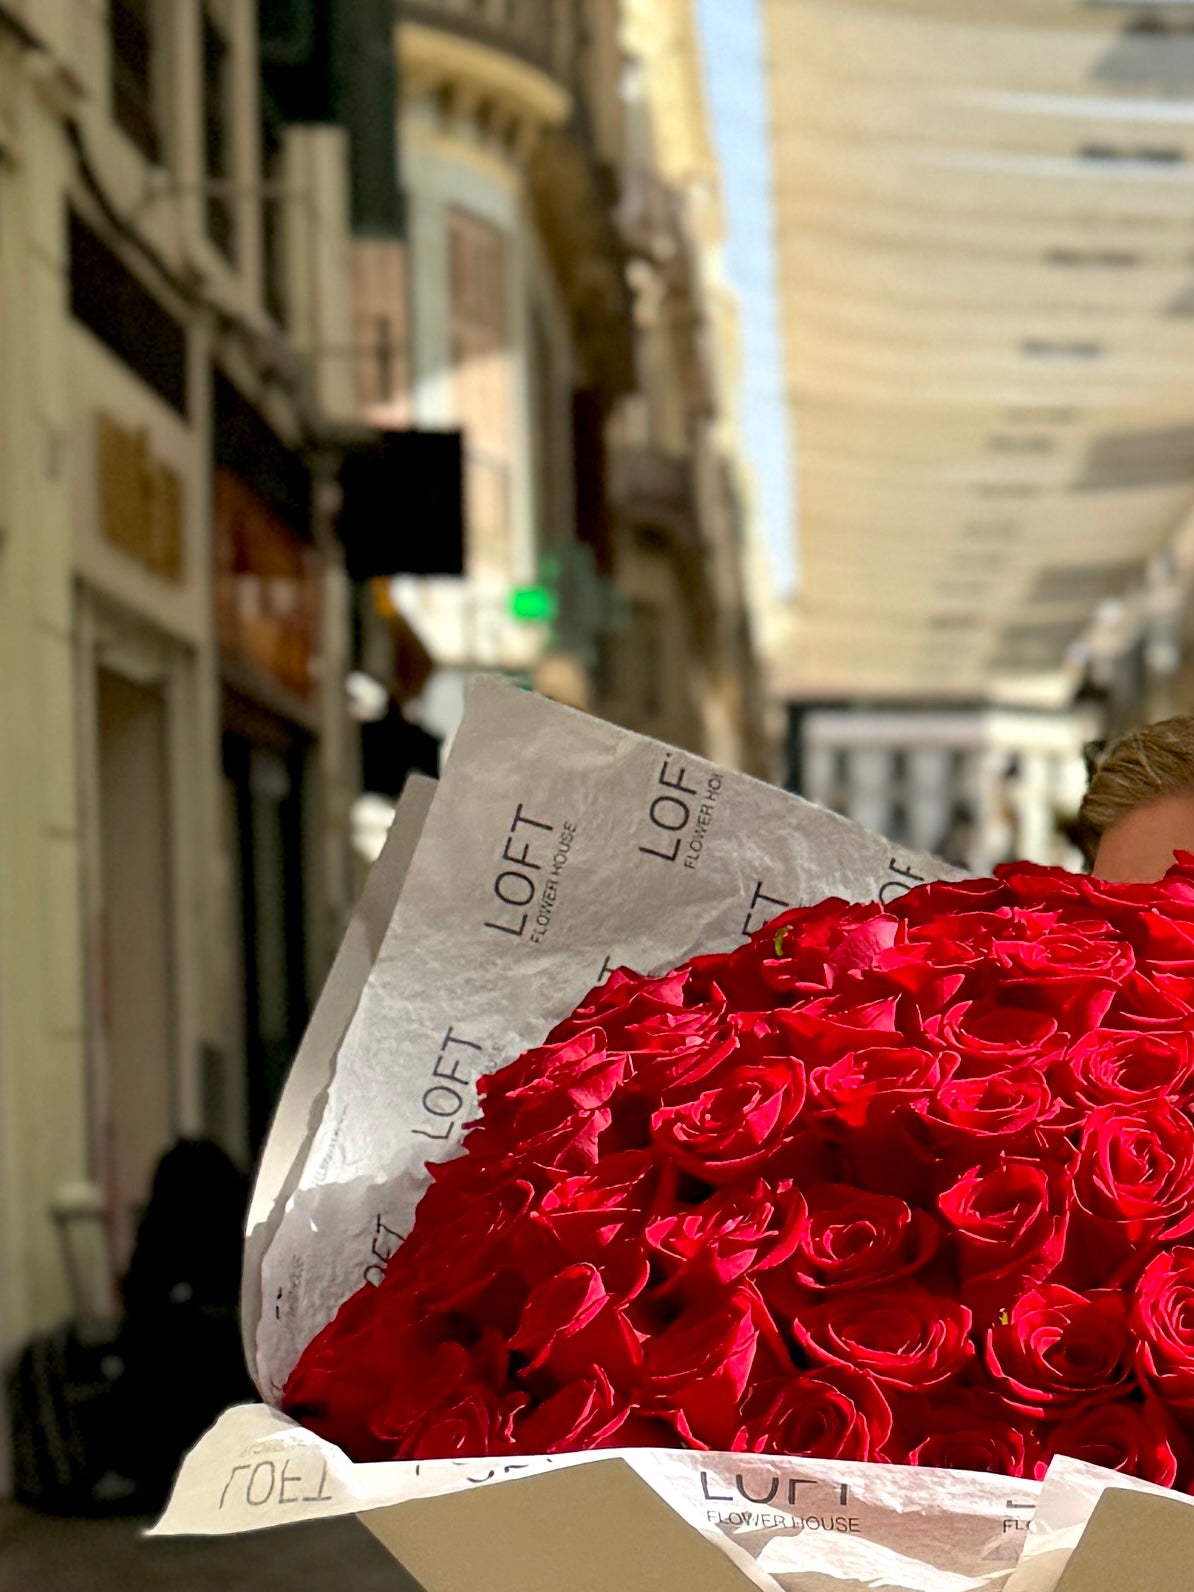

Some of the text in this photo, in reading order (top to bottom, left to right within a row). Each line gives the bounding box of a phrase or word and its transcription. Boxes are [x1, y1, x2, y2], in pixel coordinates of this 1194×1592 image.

[639, 752, 697, 862] LOF
[684, 803, 714, 870] FLOWER
[484, 803, 554, 937] LOFT
[530, 821, 577, 944] FLOWER HOUSE
[411, 1026, 483, 1140] LOFT
[363, 1213, 406, 1285] OFT
[706, 1510, 862, 1534] FLOWER HOUSE
